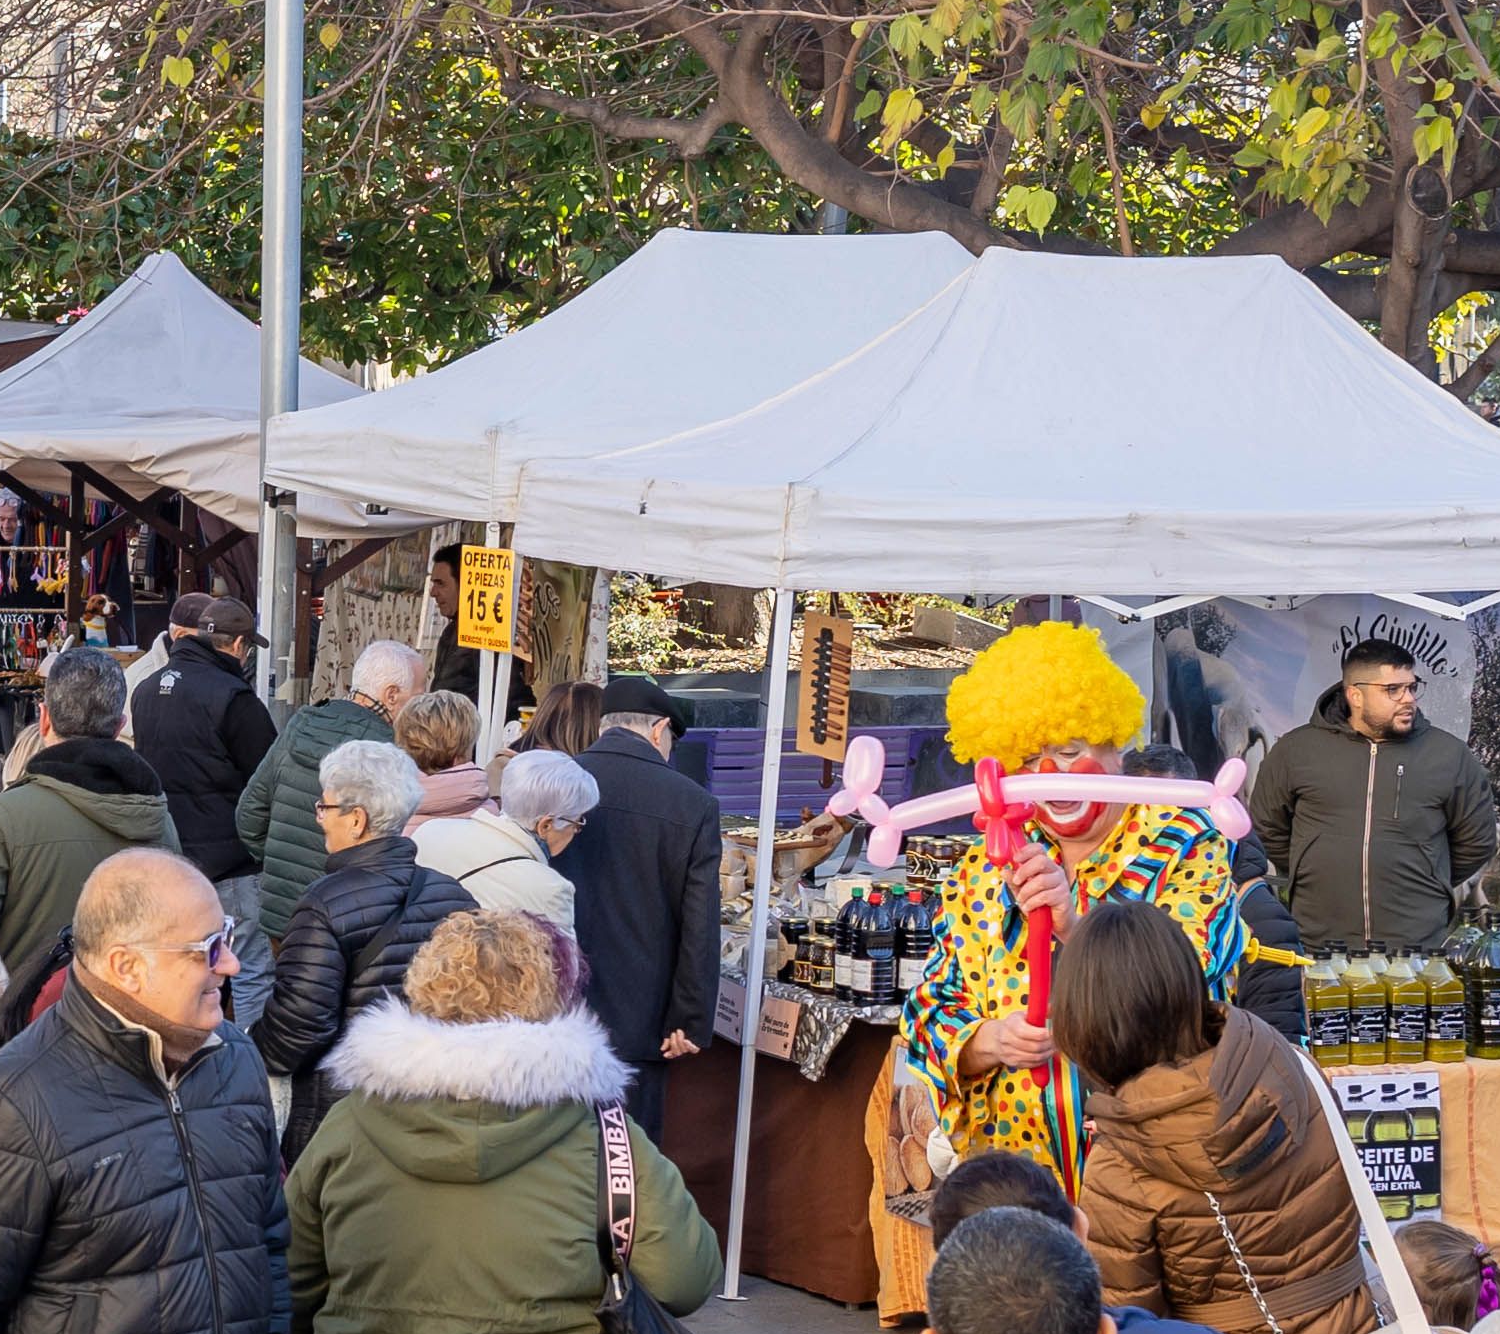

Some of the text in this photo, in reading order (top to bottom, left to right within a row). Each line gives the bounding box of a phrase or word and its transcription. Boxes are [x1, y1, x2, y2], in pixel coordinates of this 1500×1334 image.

[464, 551, 511, 571] OFERTA
[467, 571, 505, 588] 2 PIEZAS
[467, 589, 487, 622] 15
[493, 592, 504, 624] €
[1410, 1146, 1435, 1163] DE
[1363, 1164, 1415, 1183] OLIVA
[1390, 1180, 1422, 1192] EXTRA
